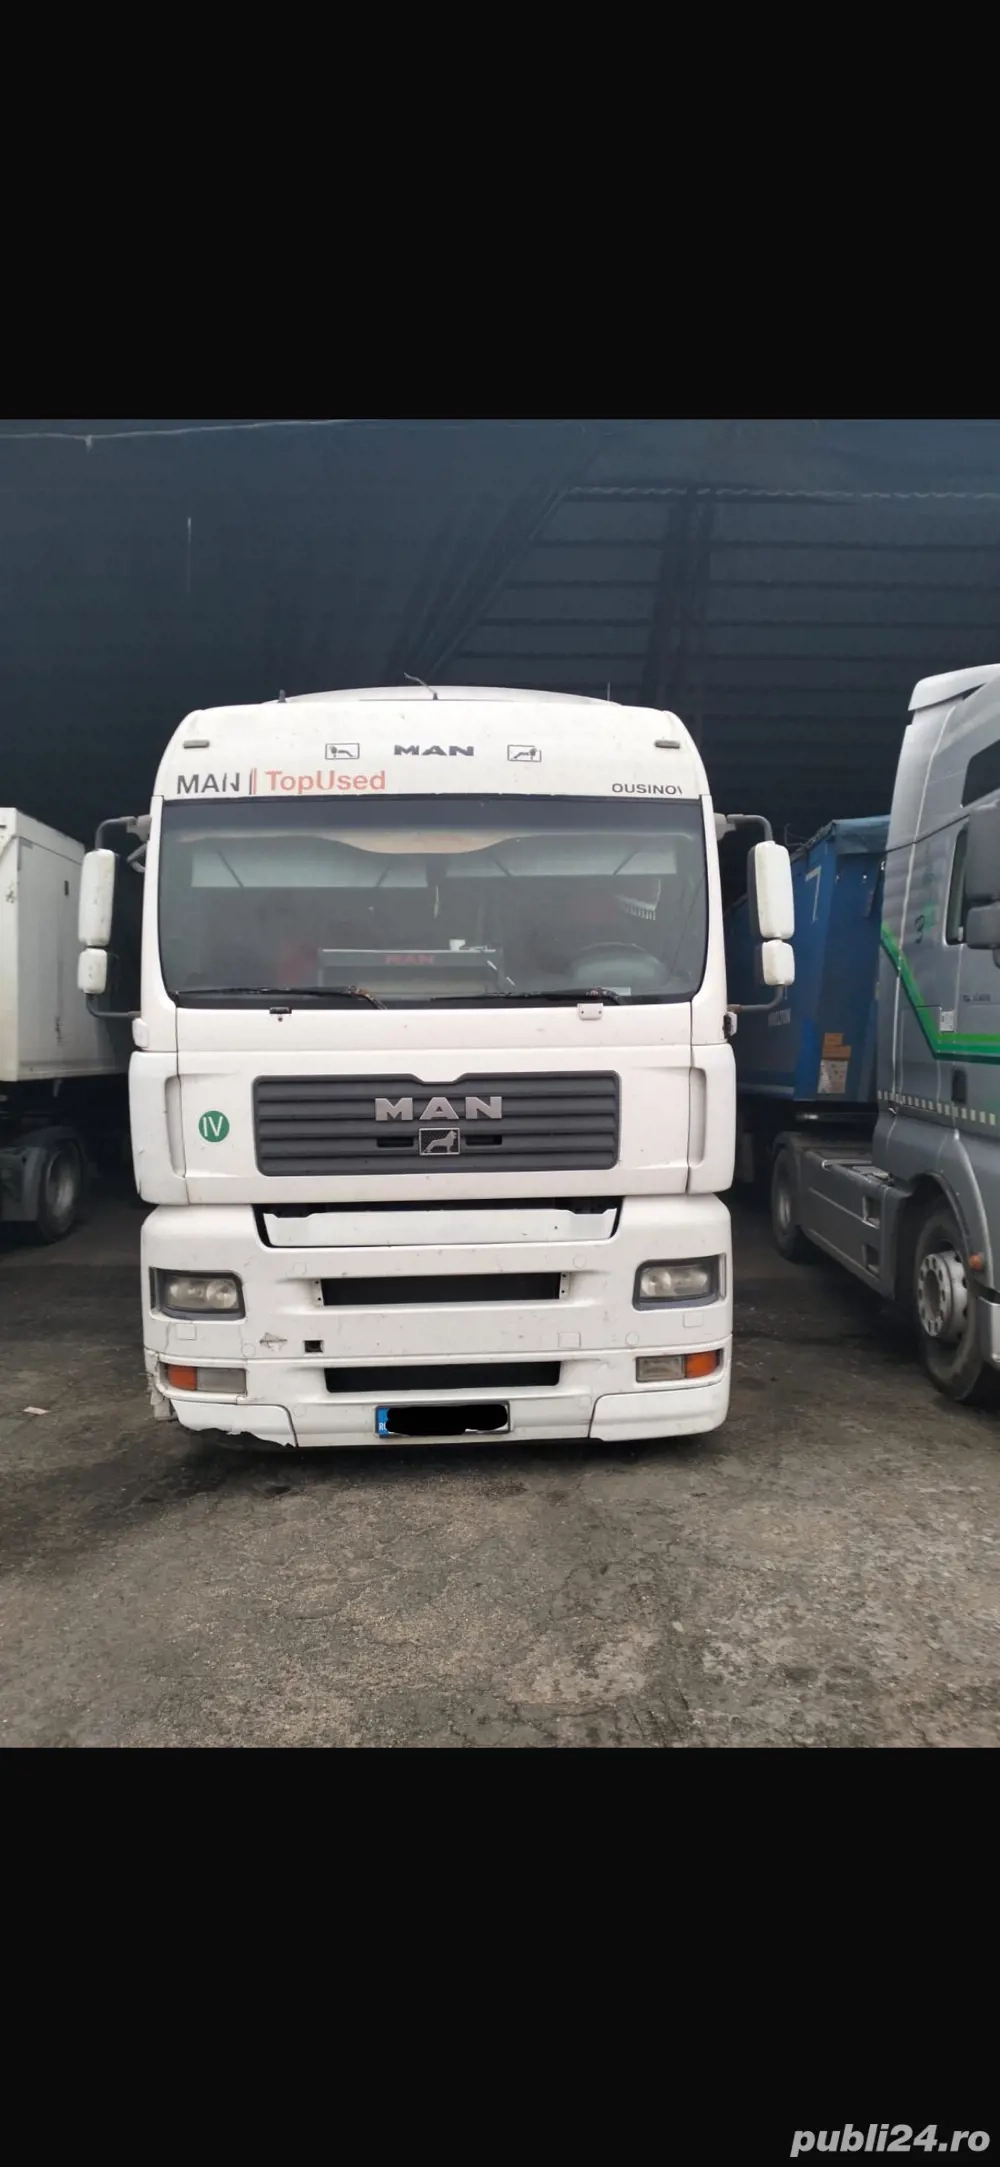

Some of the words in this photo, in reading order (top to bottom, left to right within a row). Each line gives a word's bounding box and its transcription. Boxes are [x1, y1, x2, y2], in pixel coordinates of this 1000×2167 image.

[394, 744, 474, 757] MAN
[177, 771, 240, 794] MAN
[265, 770, 386, 794] TopUsed
[375, 1096, 503, 1121] MAN
[203, 1116, 223, 1137] IV
